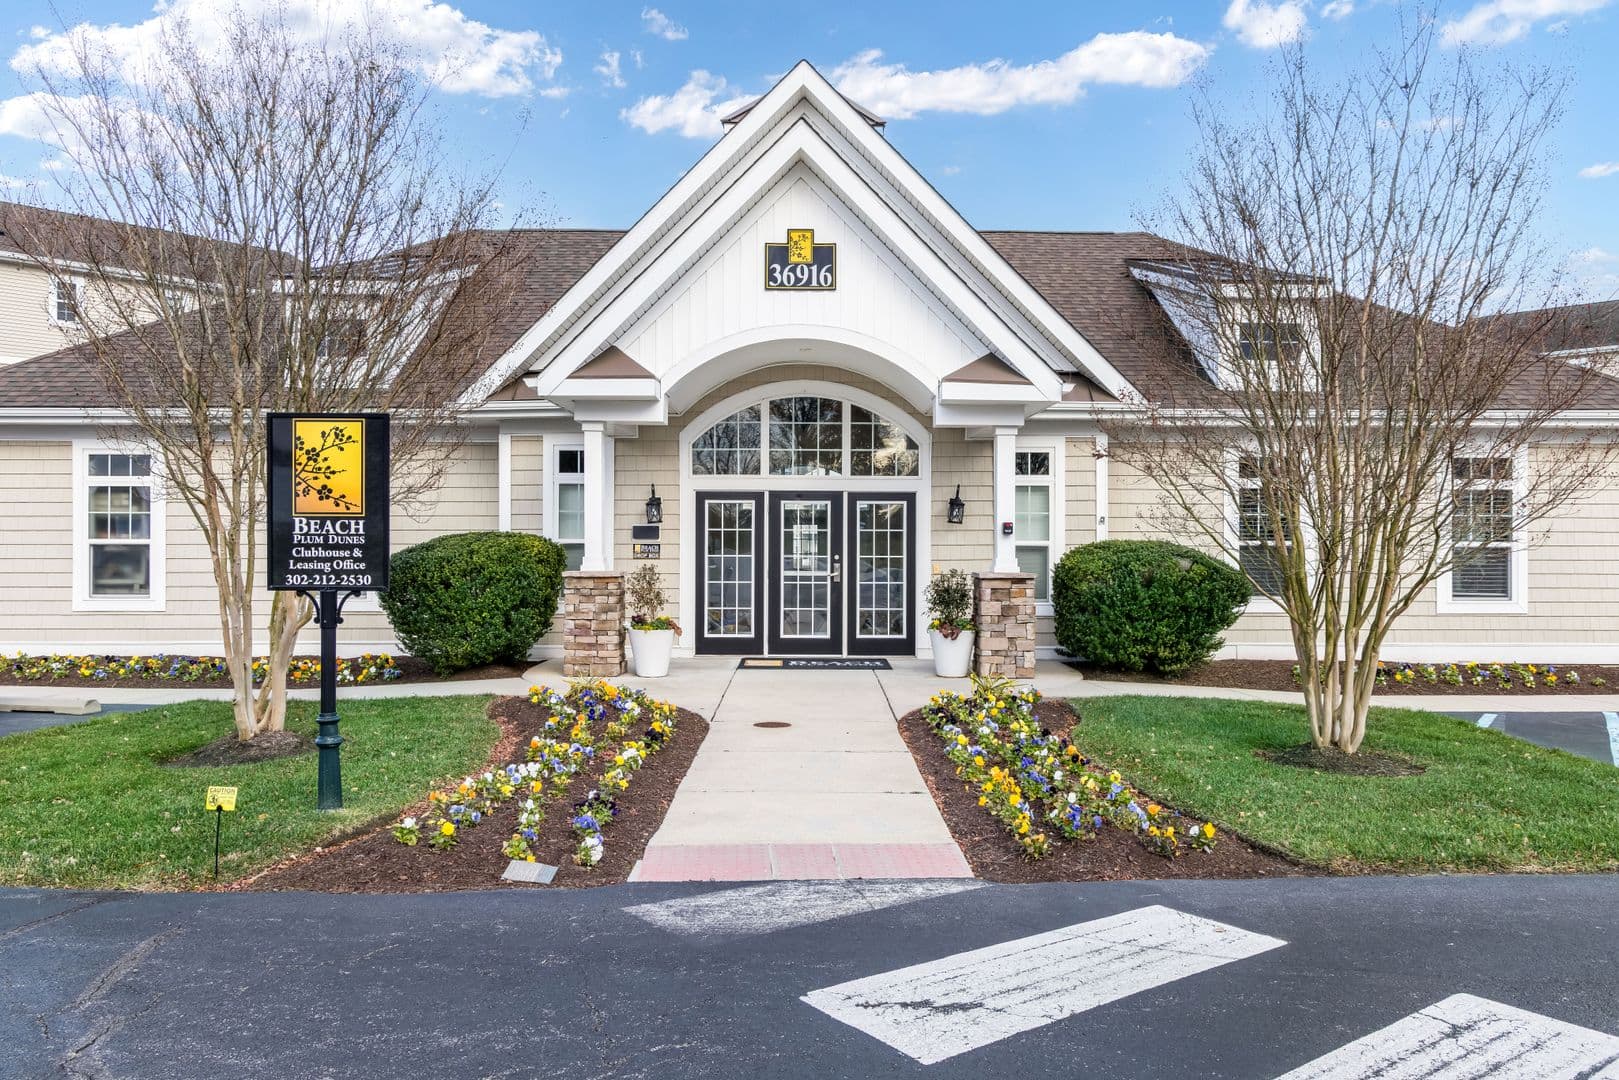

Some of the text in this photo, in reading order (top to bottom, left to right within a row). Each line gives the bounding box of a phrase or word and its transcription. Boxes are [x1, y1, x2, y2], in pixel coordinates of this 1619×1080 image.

[769, 264, 832, 286] 36916
[292, 518, 365, 535] BEACH
[293, 535, 365, 544] PLUM DUNES
[292, 547, 362, 558] Clubhouse &
[289, 559, 366, 572] Leasing Office
[285, 575, 372, 586] 302-212-2530
